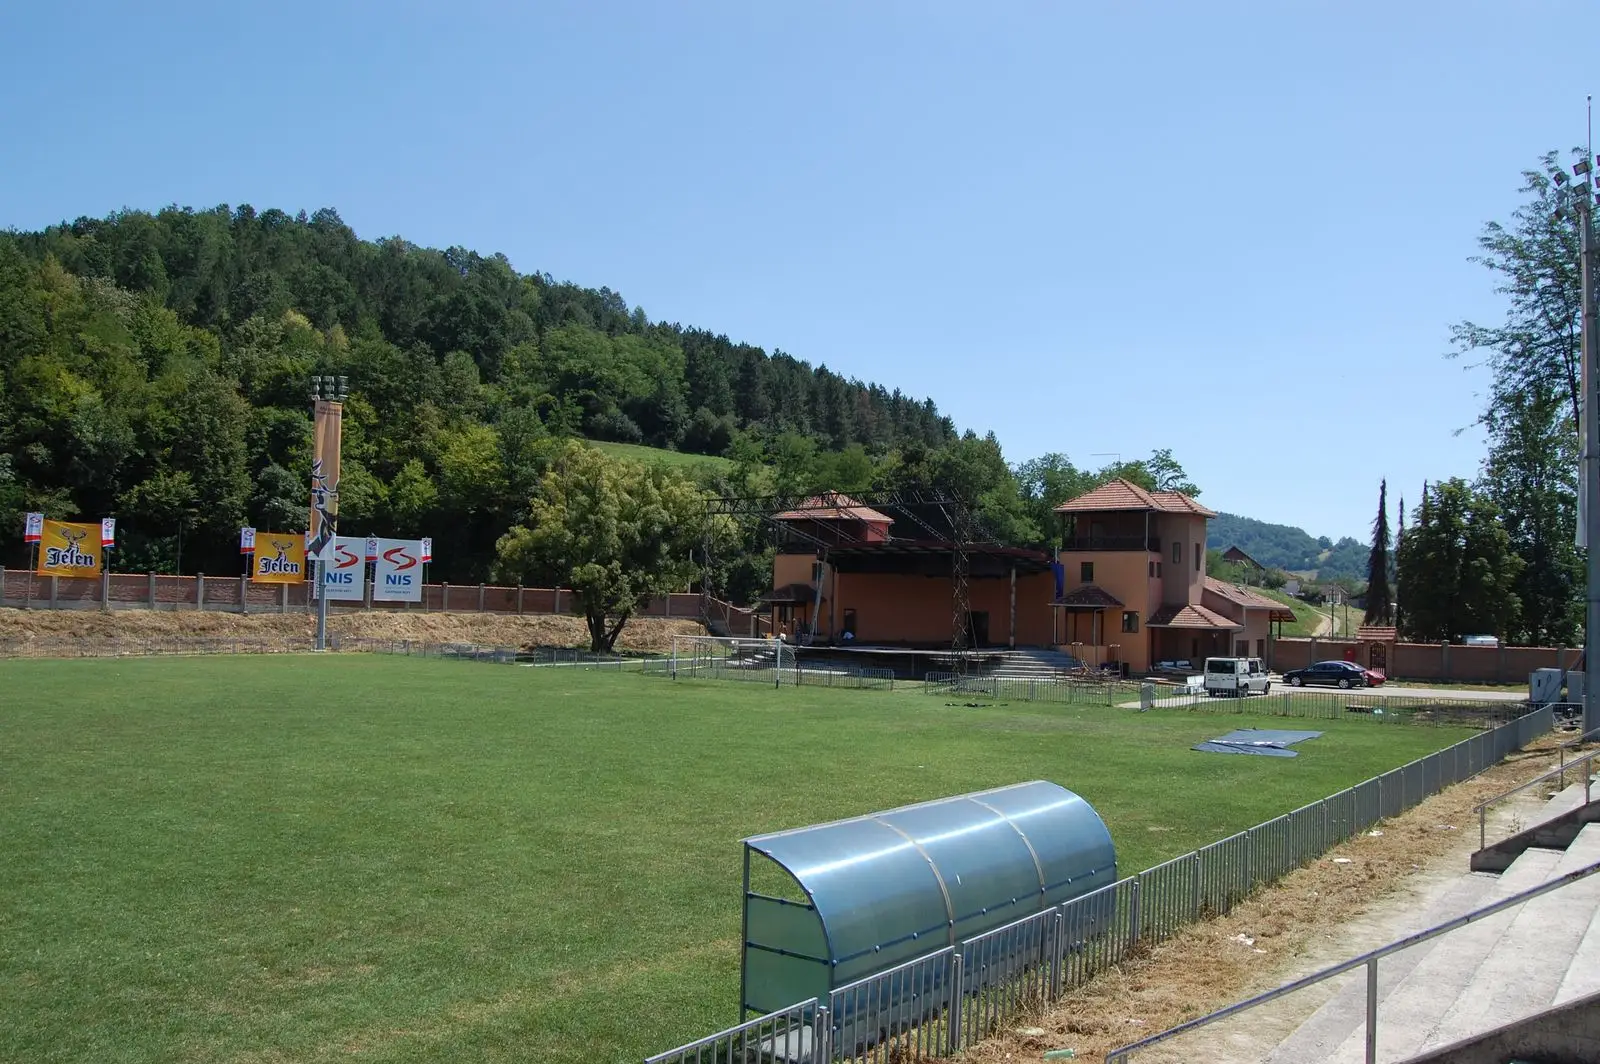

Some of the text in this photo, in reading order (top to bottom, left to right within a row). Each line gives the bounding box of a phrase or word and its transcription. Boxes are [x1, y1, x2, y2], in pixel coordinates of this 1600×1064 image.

[46, 547, 94, 567] Jelen
[258, 557, 300, 574] Jelen
[326, 573, 353, 584] NIS
[386, 574, 412, 585] NIS
